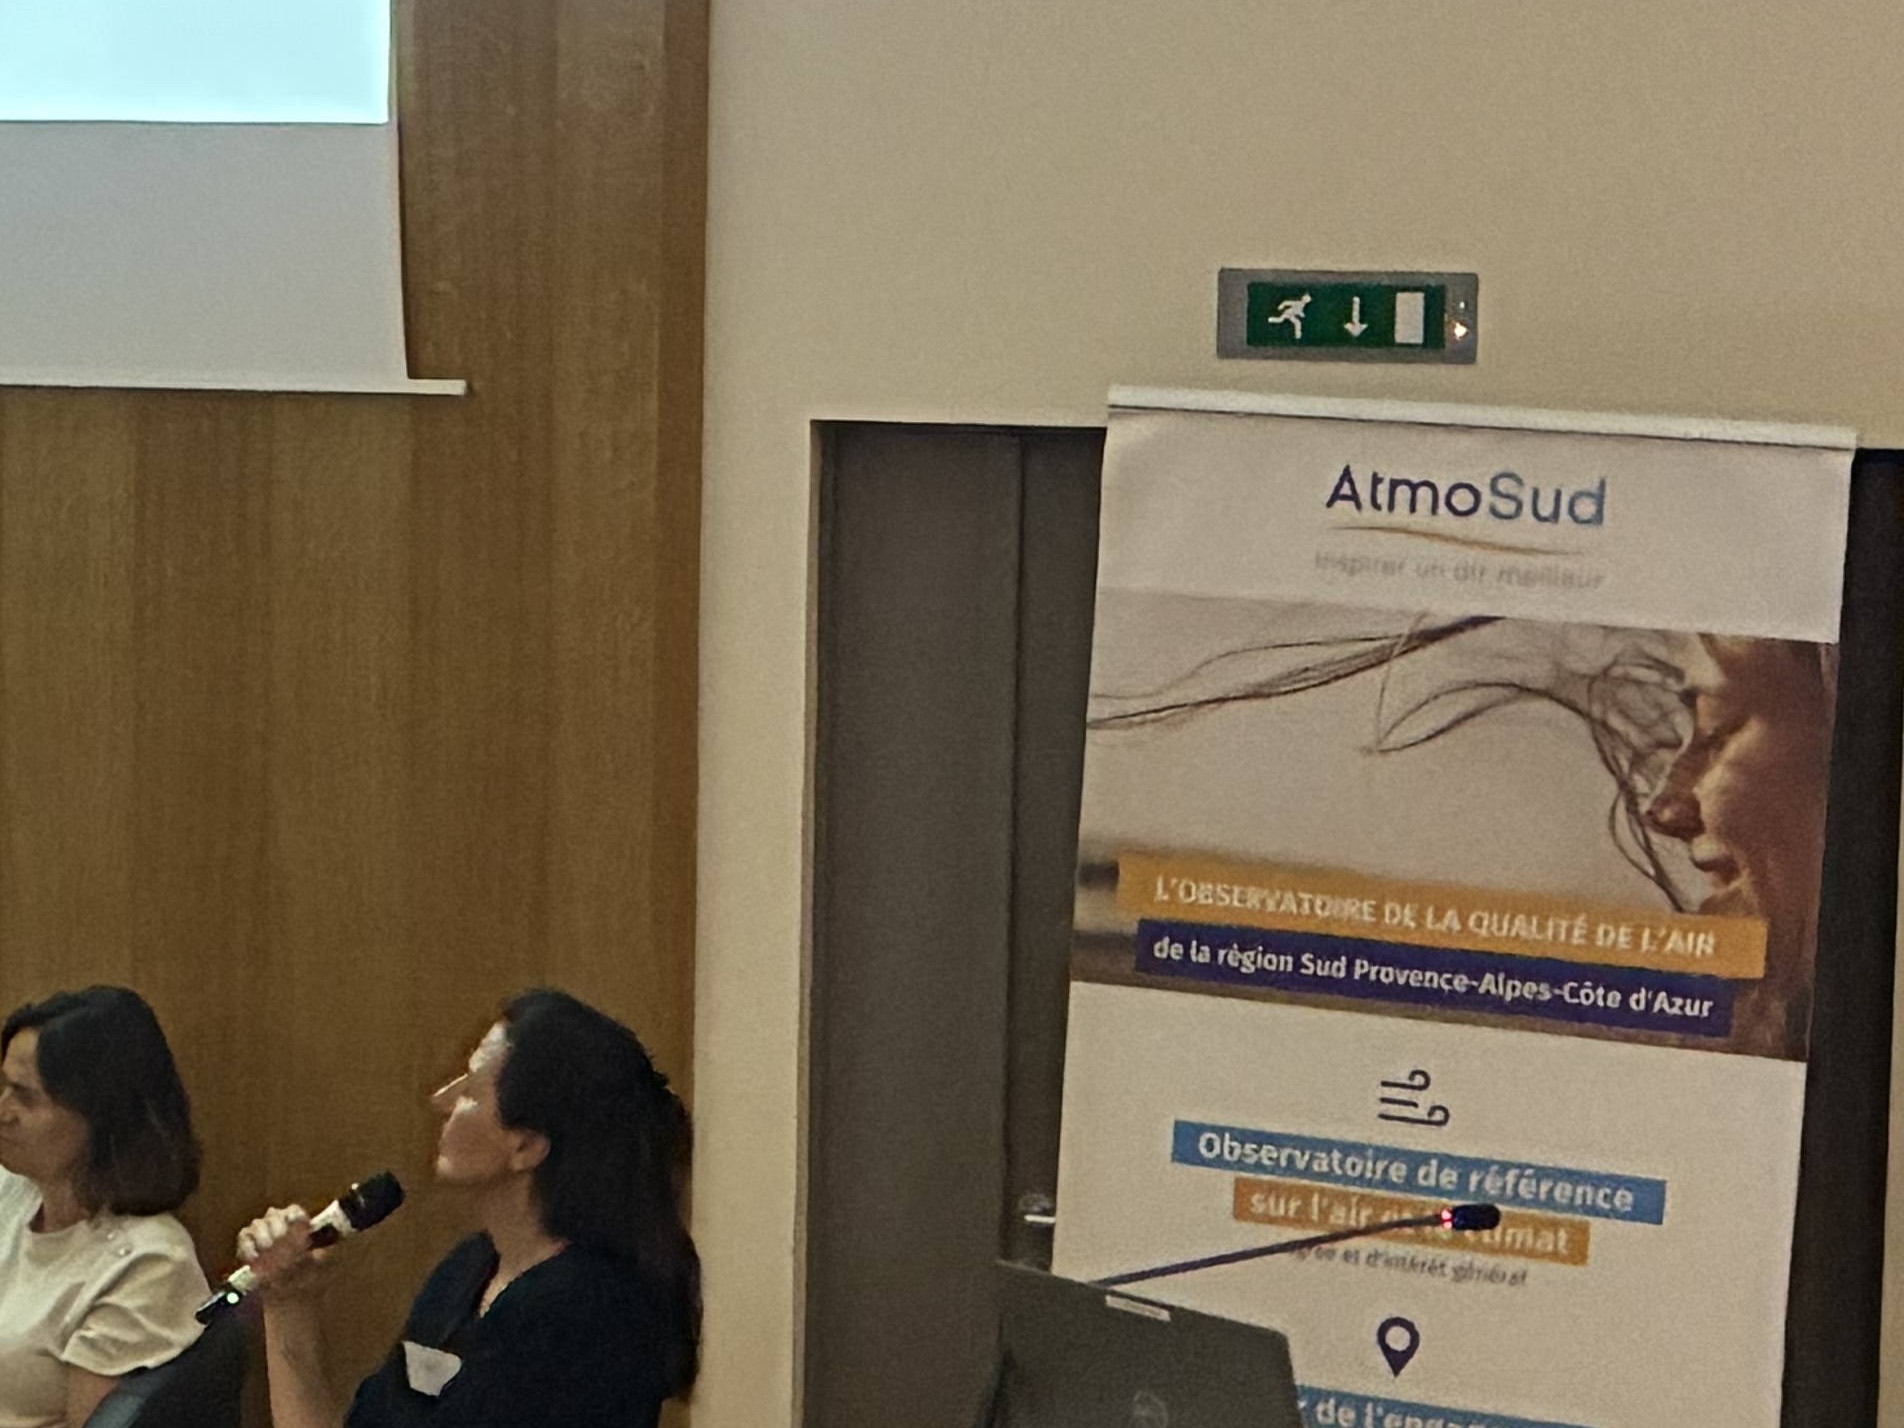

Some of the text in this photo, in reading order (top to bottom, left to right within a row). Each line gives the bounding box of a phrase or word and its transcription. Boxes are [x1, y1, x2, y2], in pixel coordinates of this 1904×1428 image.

[1325, 463, 1607, 526] AtmoSud
[1154, 874, 1716, 958] L'OBSERVATOIRE DE LA QUALITÉ DE L'AIR
[1153, 935, 1184, 961] de
[1190, 939, 1211, 964] la
[1217, 943, 1294, 974] région
[1300, 952, 1347, 979] Sud
[1628, 986, 1714, 1019] d'Azur
[1198, 1131, 1635, 1212] Observatoire de référence
[1250, 1192, 1302, 1217] sur
[1316, 1396, 1356, 1428] de
